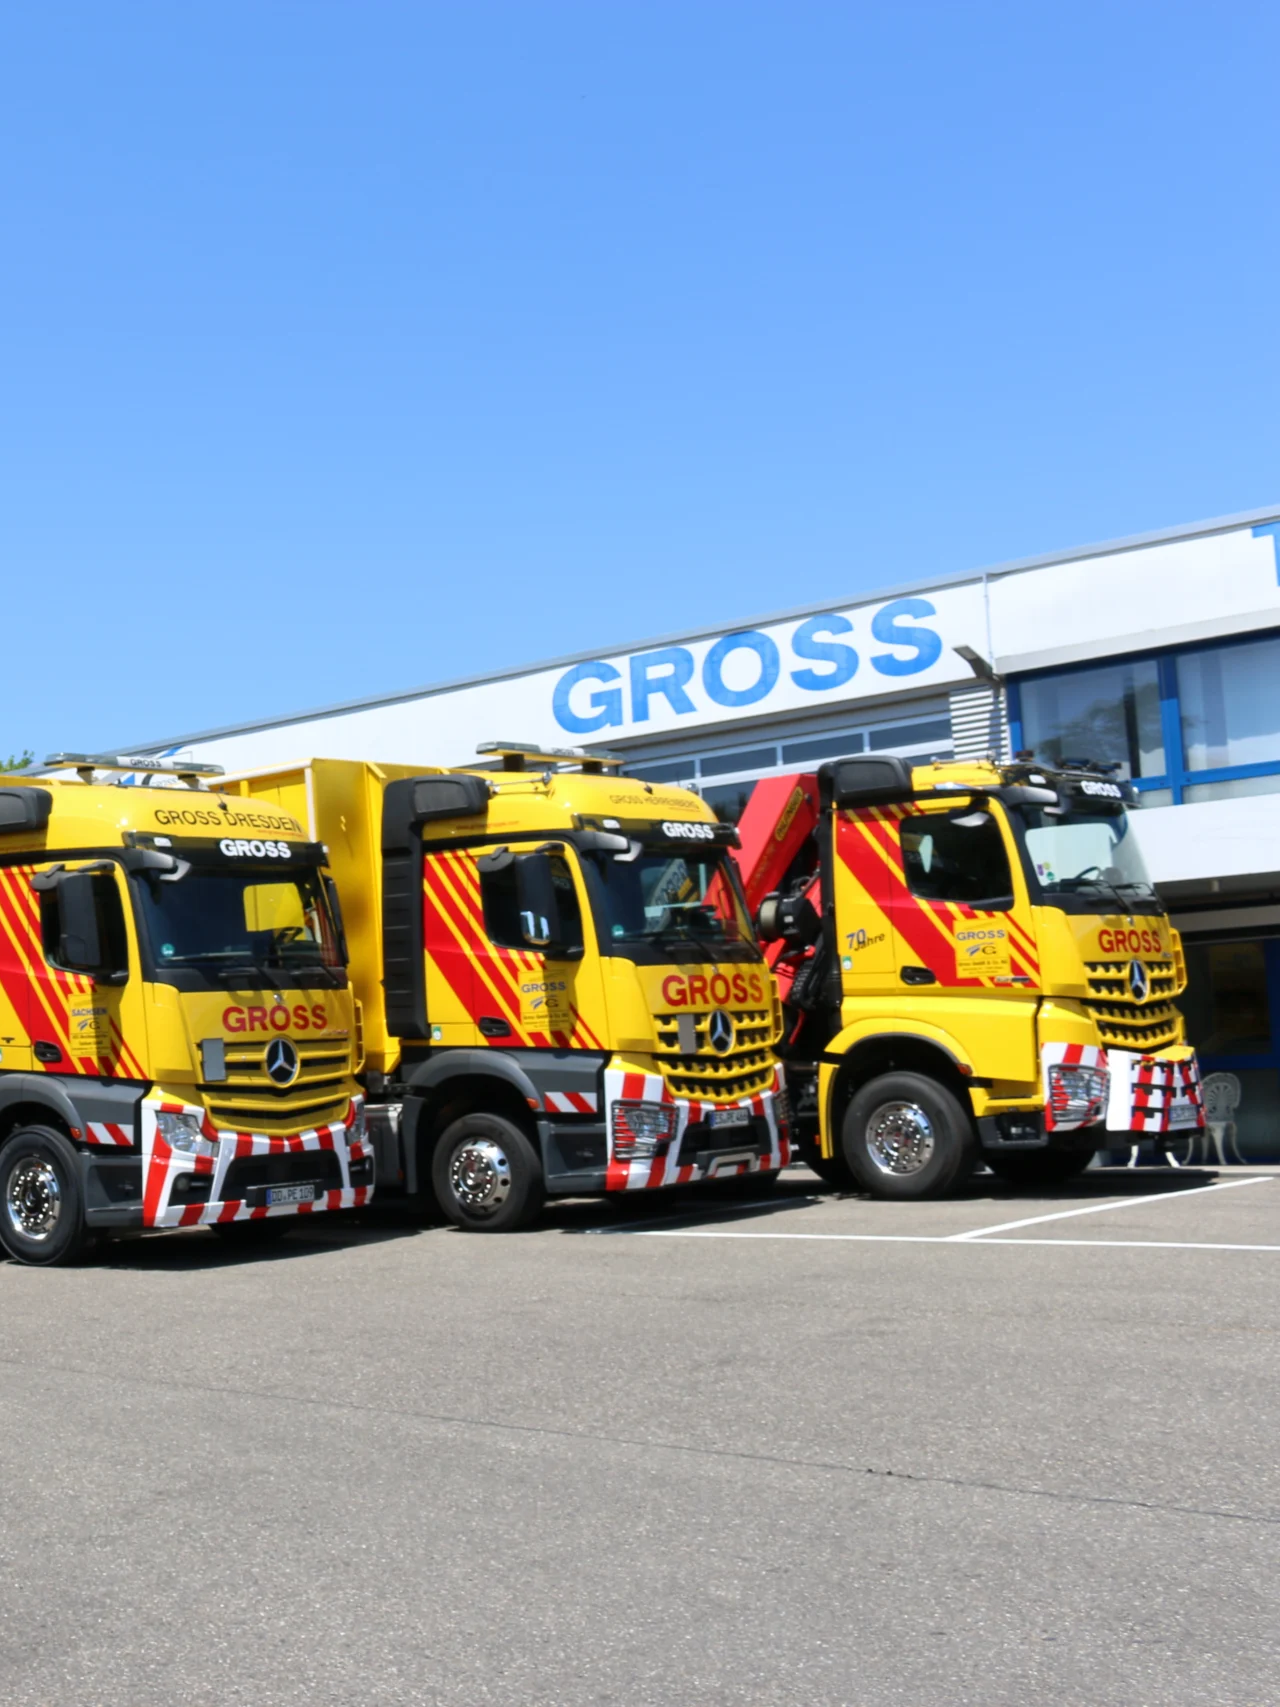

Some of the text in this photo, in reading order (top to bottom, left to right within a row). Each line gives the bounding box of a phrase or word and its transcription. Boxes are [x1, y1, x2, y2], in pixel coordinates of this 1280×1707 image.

[552, 599, 942, 734] GROSS
[130, 758, 161, 767] GROSS
[1081, 781, 1121, 797] GROSS
[154, 809, 221, 825] GROSS
[223, 812, 303, 833] DRESDEN
[662, 822, 714, 839] GROSS
[220, 839, 291, 858] GROSS
[846, 929, 866, 949] 70
[956, 930, 1005, 941] GROSS
[1098, 929, 1162, 953] GROSS
[521, 982, 566, 993] GROSS
[662, 973, 764, 1006] GROSS
[222, 1004, 328, 1033] GROSS
